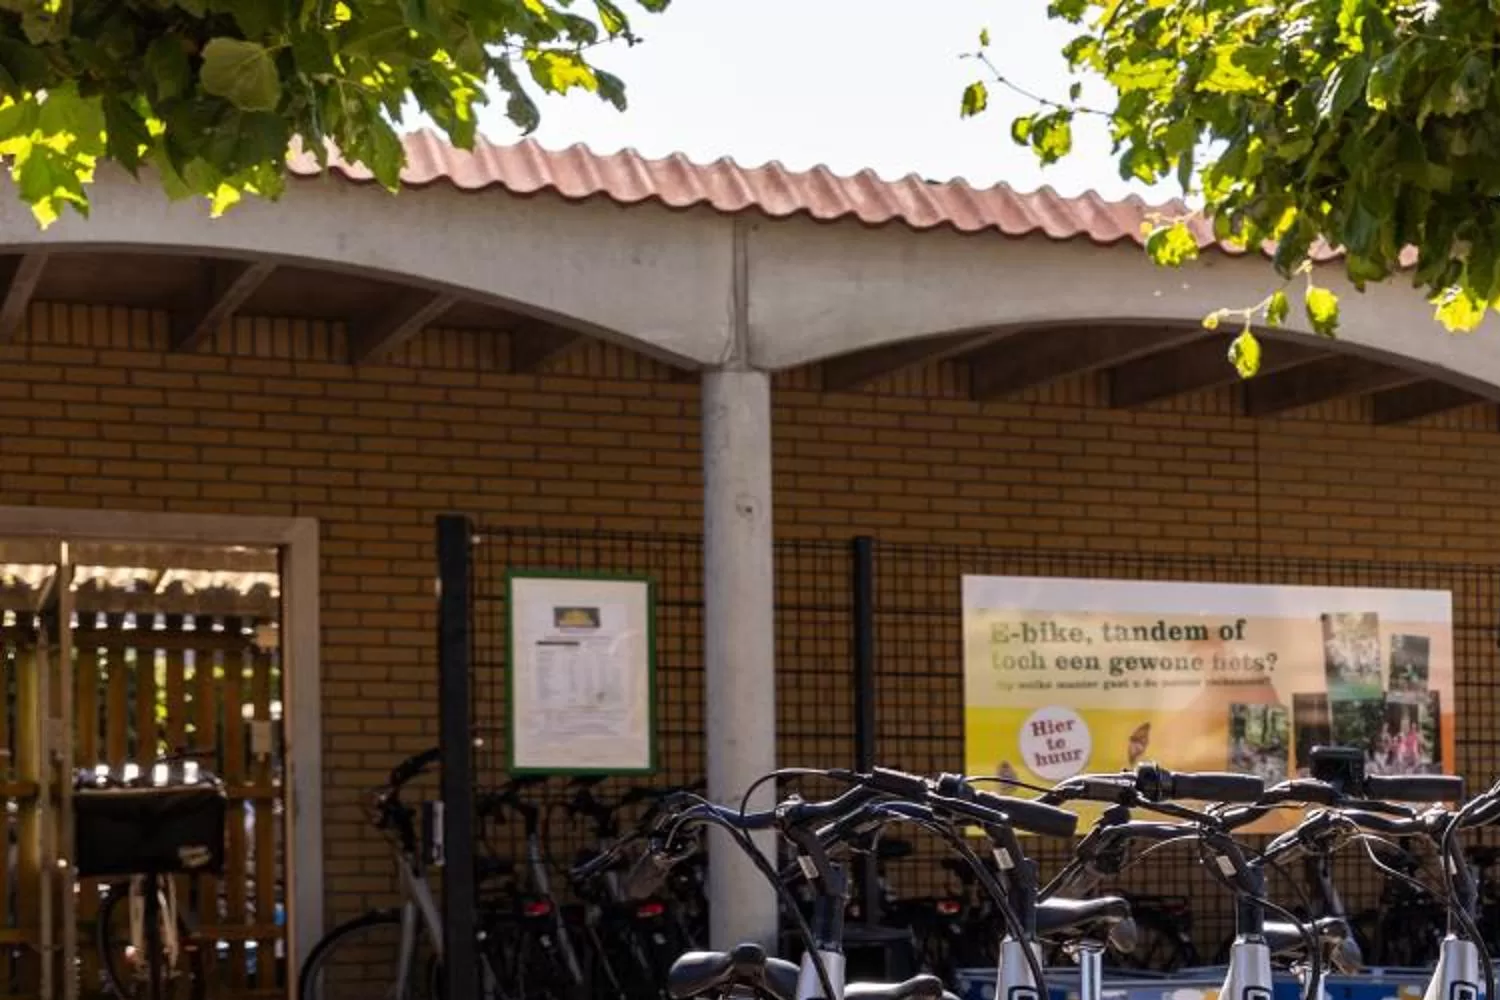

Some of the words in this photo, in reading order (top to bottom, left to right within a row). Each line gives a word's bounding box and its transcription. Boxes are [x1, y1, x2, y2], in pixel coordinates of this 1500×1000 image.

[991, 620, 1094, 645] E-bike,
[1102, 618, 1209, 643] tandem
[1218, 618, 1247, 641] of
[991, 650, 1047, 671] toch
[1055, 655, 1102, 671] een
[1109, 655, 1204, 676] gewone
[1212, 652, 1278, 672] fiets?
[1030, 720, 1076, 737] Hier
[1046, 738, 1066, 751] te
[1034, 749, 1082, 768] huur
